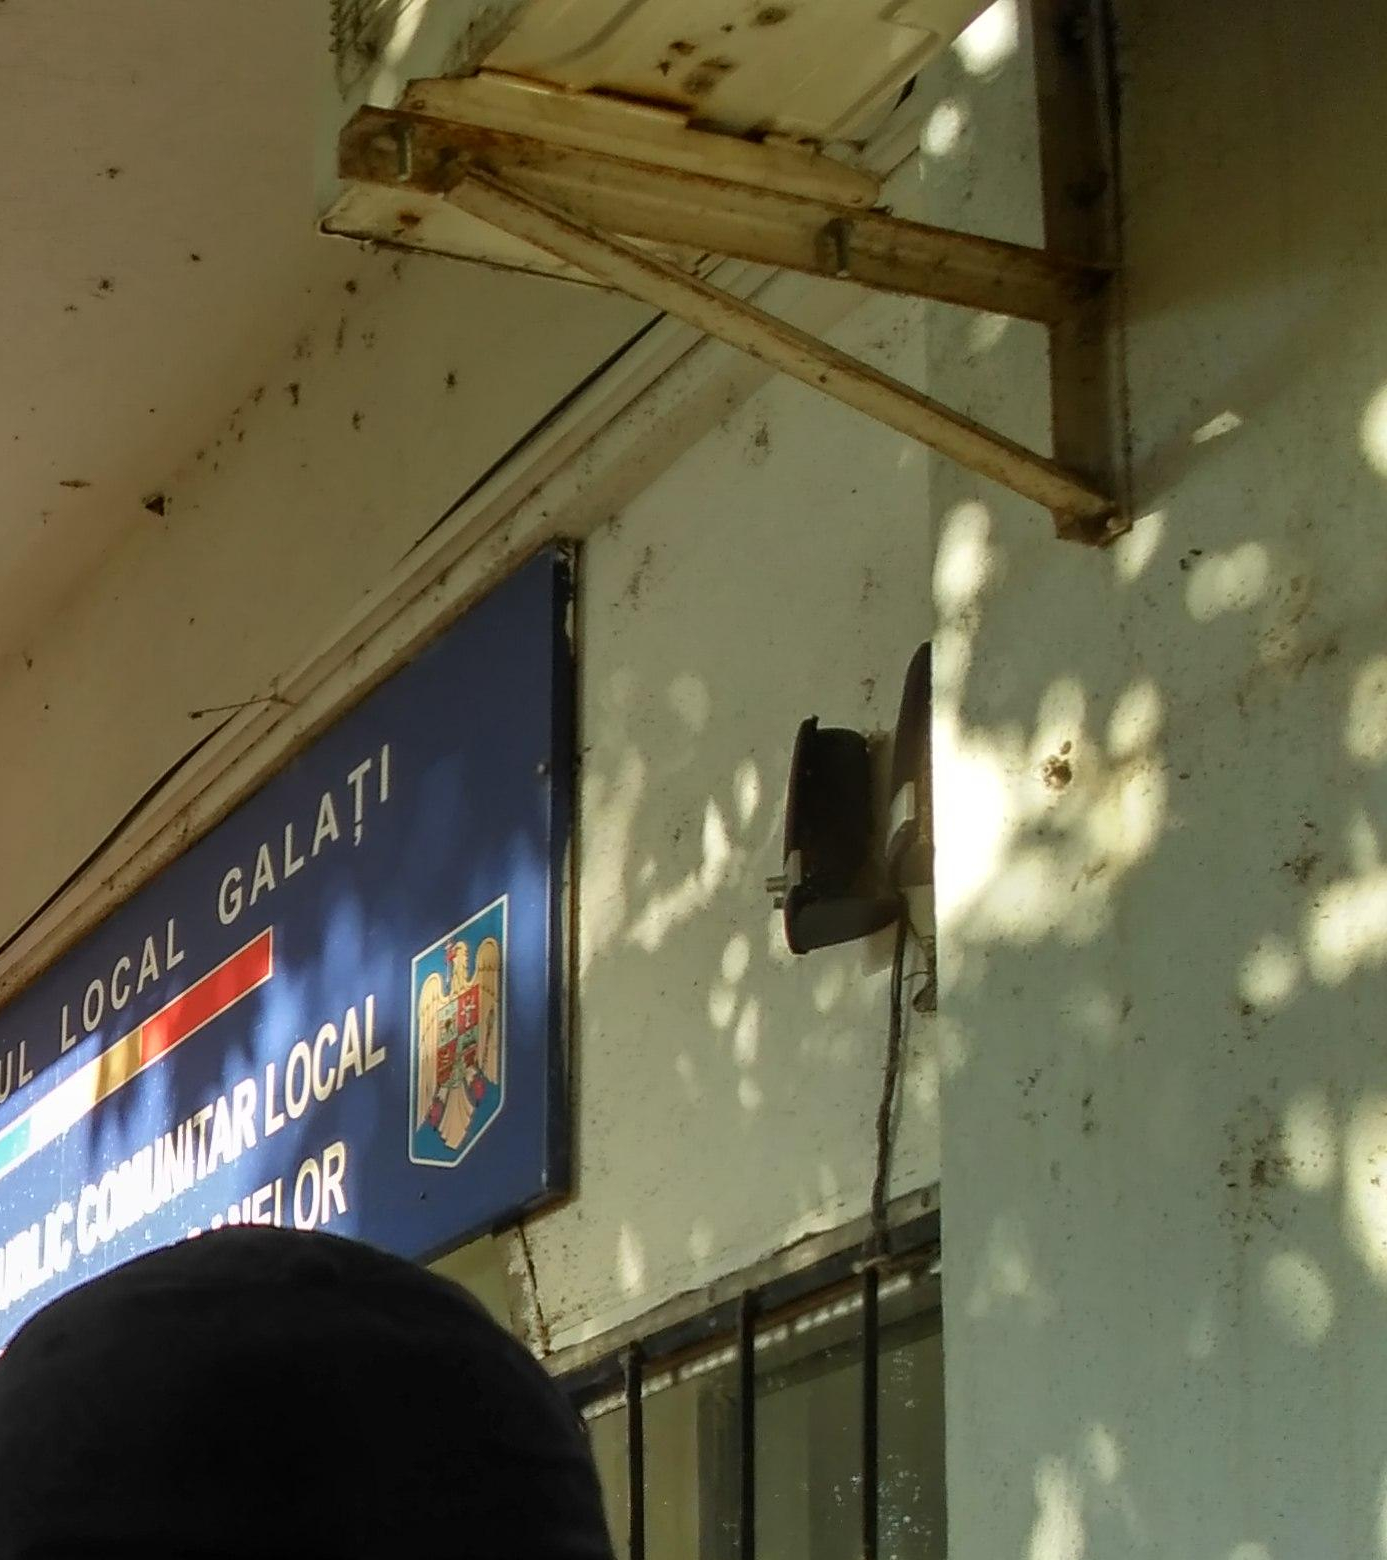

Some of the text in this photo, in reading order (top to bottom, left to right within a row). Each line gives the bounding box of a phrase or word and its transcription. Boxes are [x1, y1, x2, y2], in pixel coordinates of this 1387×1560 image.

[60, 918, 186, 1054] LOCAL
[218, 743, 391, 925] GALAȚI
[77, 1078, 257, 1255] COMUNITAR
[264, 994, 385, 1137] LOCAL
